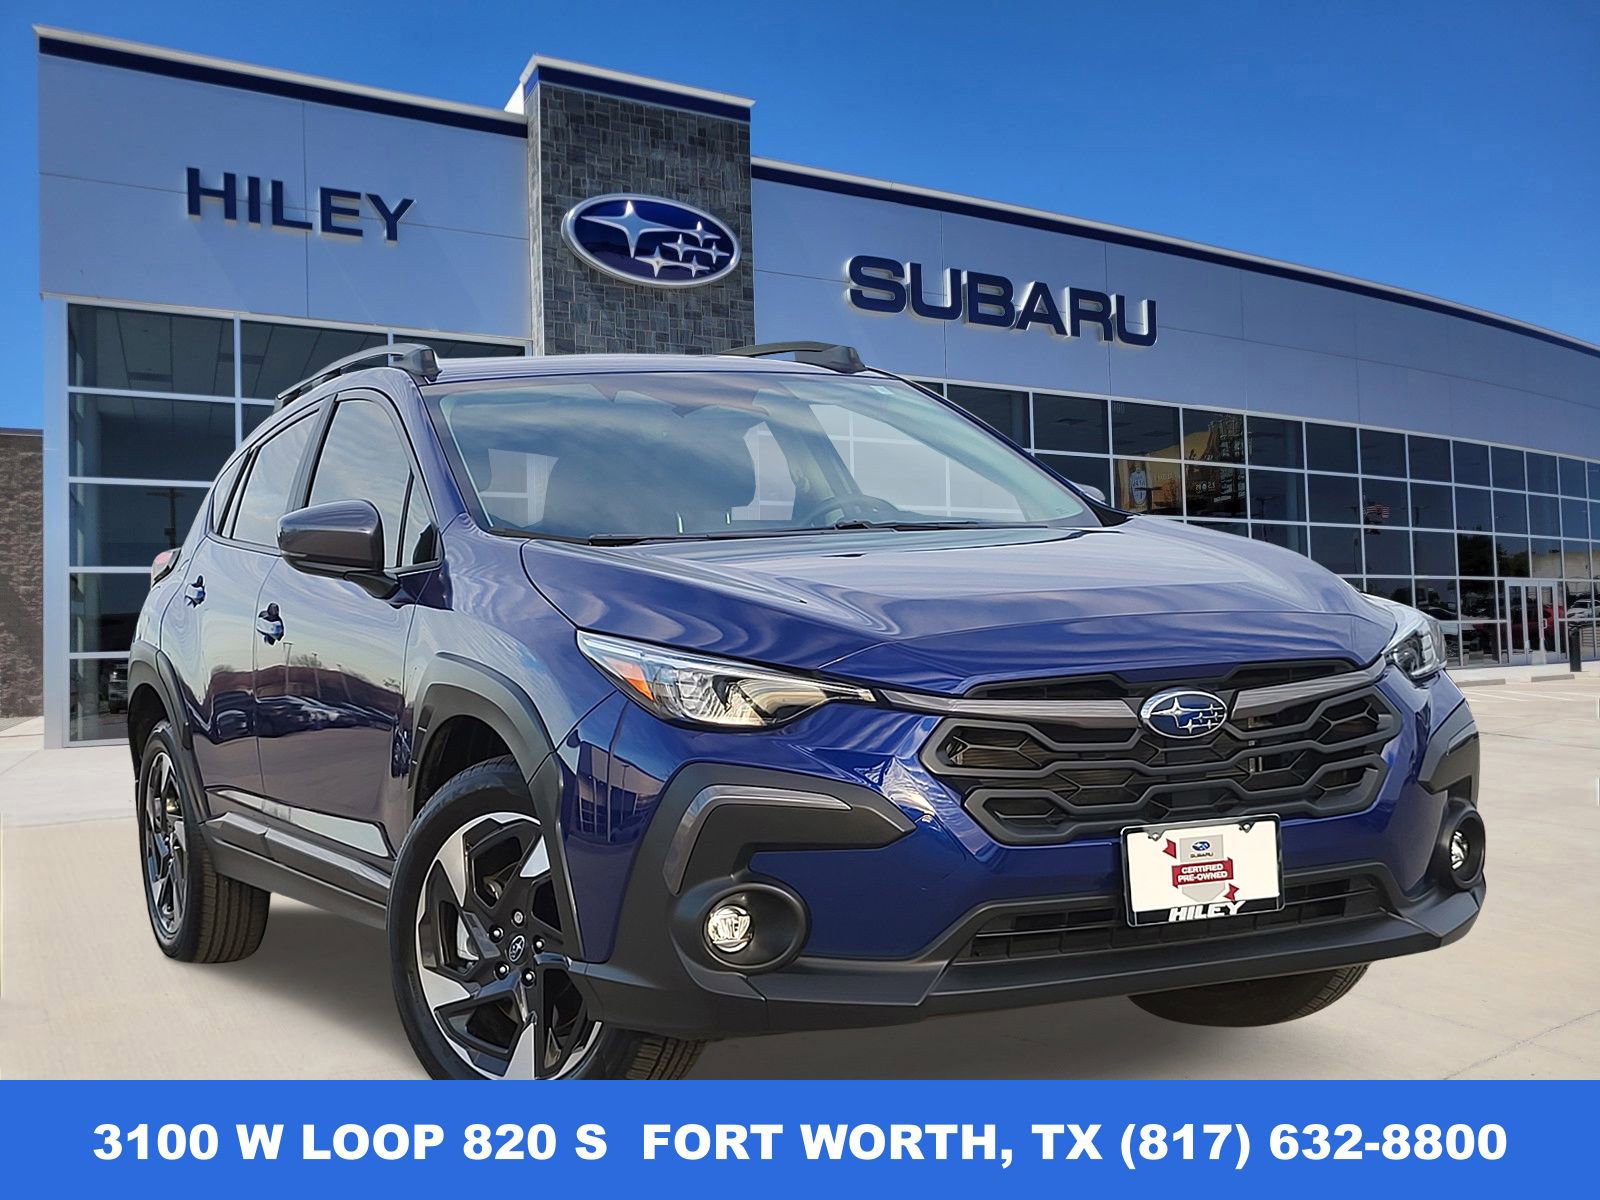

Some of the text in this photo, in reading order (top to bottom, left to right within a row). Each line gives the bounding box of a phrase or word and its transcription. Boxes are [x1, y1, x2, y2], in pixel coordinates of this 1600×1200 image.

[186, 166, 416, 242] HILEY
[847, 254, 1158, 347] SUBARU
[1190, 851, 1214, 859] SUBARU
[1177, 870, 1228, 883] PRE-OWNED
[1181, 863, 1224, 874] CERTIFIED
[1168, 900, 1246, 922] HILEY
